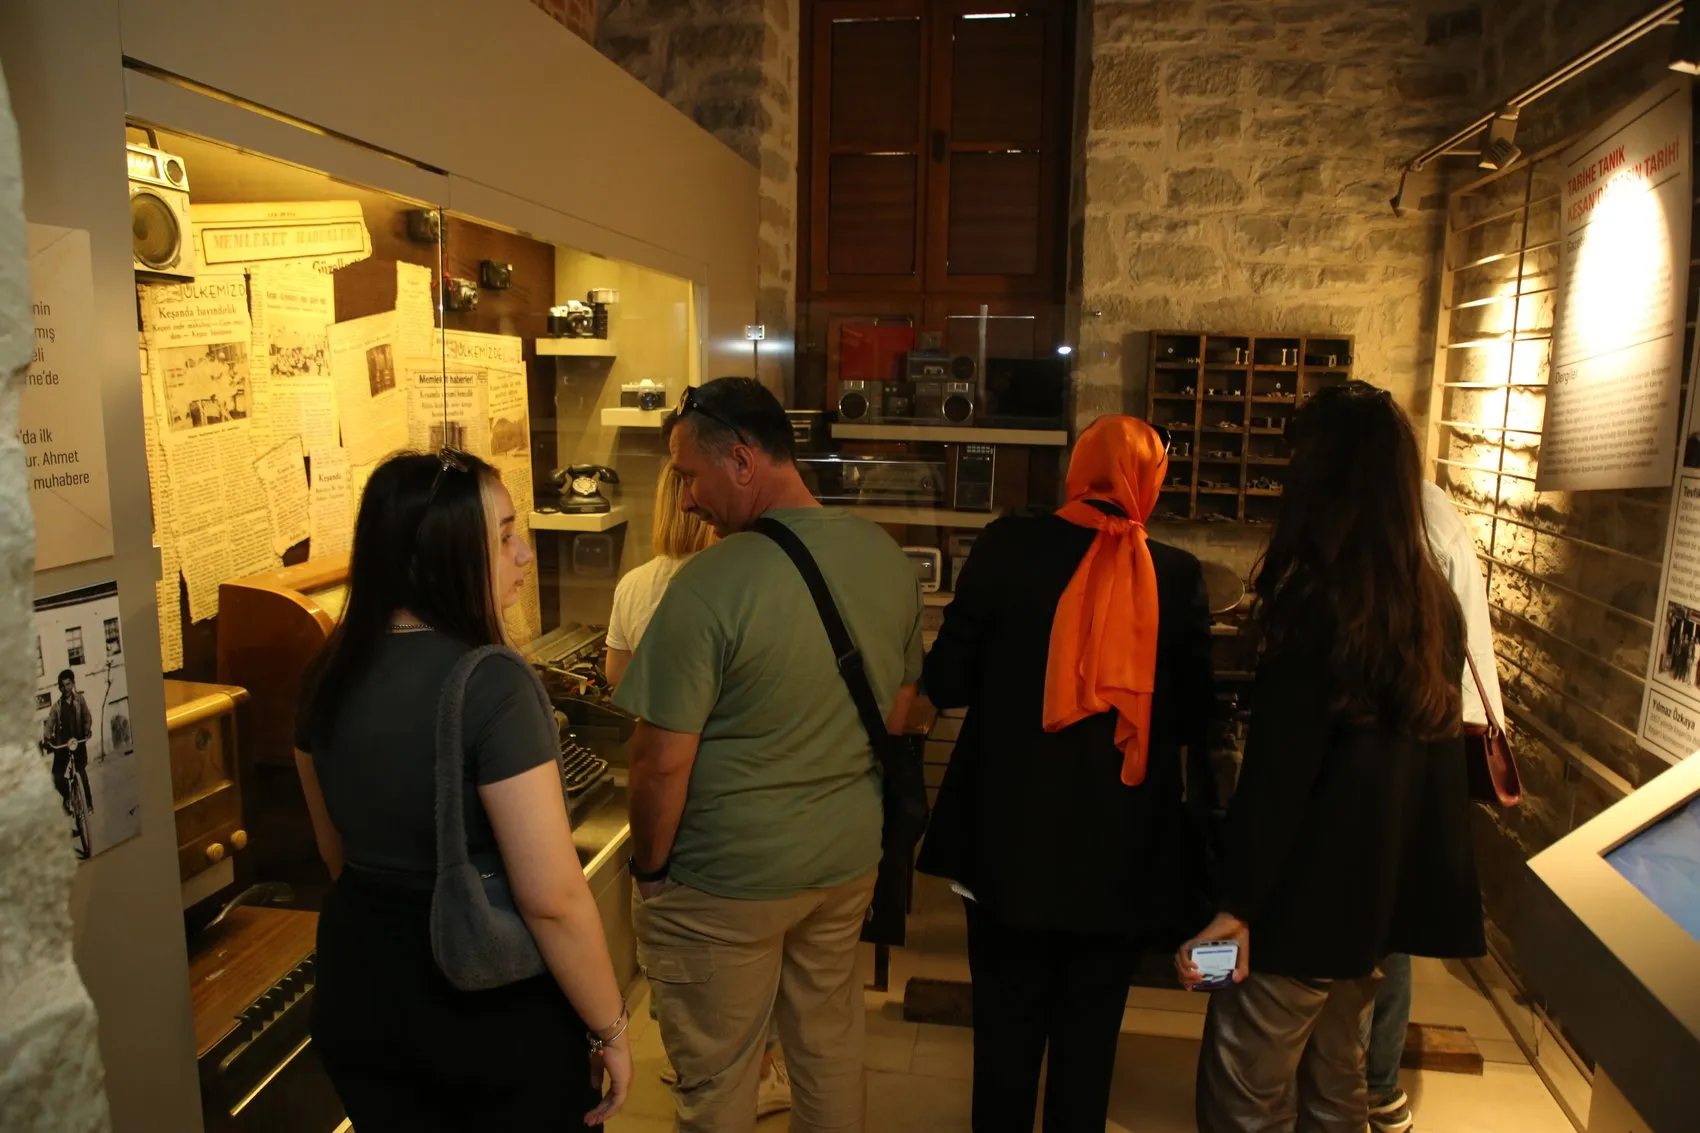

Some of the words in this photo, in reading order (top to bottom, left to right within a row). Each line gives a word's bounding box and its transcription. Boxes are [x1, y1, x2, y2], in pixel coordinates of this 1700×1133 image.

[1644, 136, 1680, 178] TARİHİ
[1567, 163, 1597, 197] TARİHE
[1598, 144, 1626, 177] TANIK
[158, 305, 195, 320] Keşanda
[26, 370, 60, 386] ne'de
[419, 374, 448, 384] Memlekt
[39, 428, 53, 443] ilk
[42, 450, 80, 466] Ahmet
[33, 472, 90, 490] muhabere
[1652, 698, 1672, 718] Yılmaz
[1672, 707, 1696, 731] Özkaya
